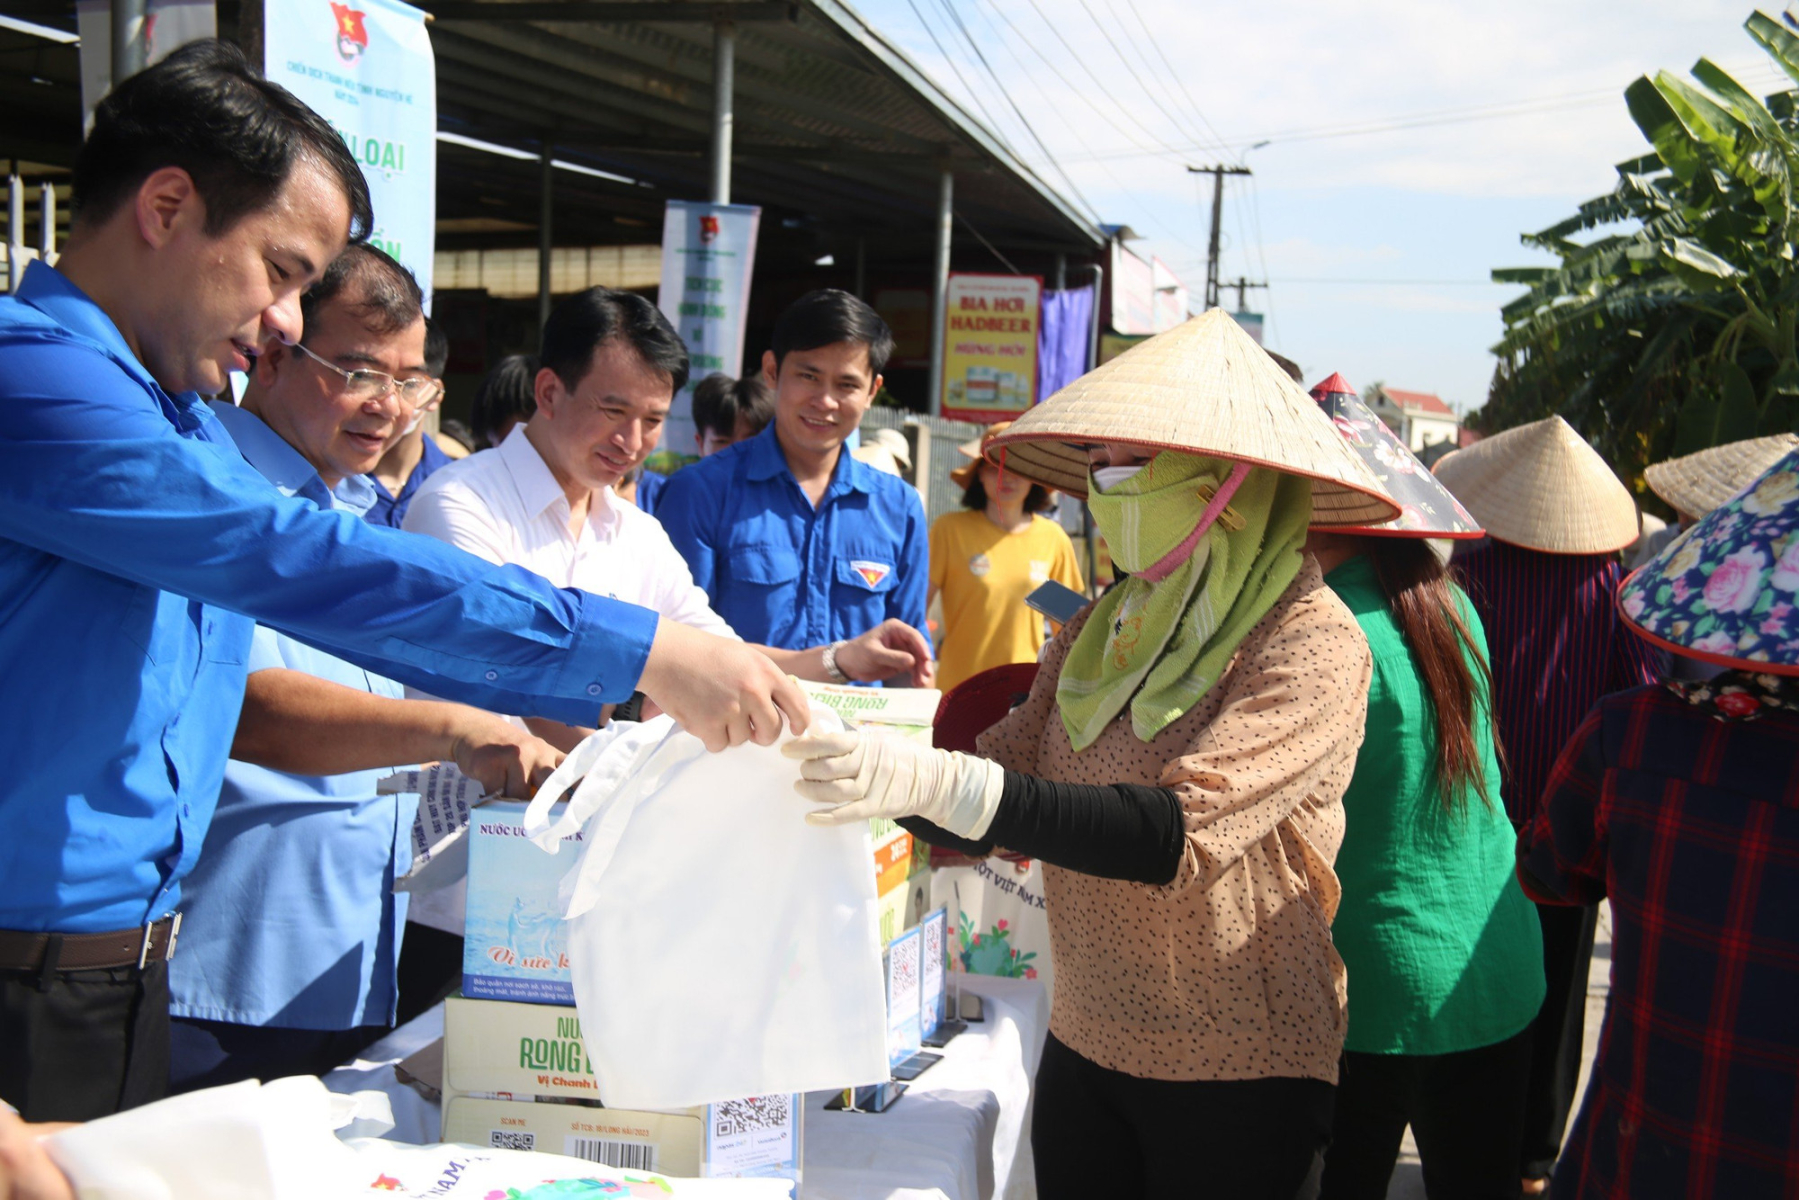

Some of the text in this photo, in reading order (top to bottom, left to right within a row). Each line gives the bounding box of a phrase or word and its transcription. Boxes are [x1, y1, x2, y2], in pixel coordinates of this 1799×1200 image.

[352, 134, 405, 179] LOẠI
[959, 296, 988, 312] BIA
[950, 316, 1031, 333] HADBEER
[994, 873, 1018, 895] VIỆT
[520, 1037, 582, 1073] RONG
[537, 1075, 550, 1088] Vị
[552, 1076, 591, 1089] Chanh
